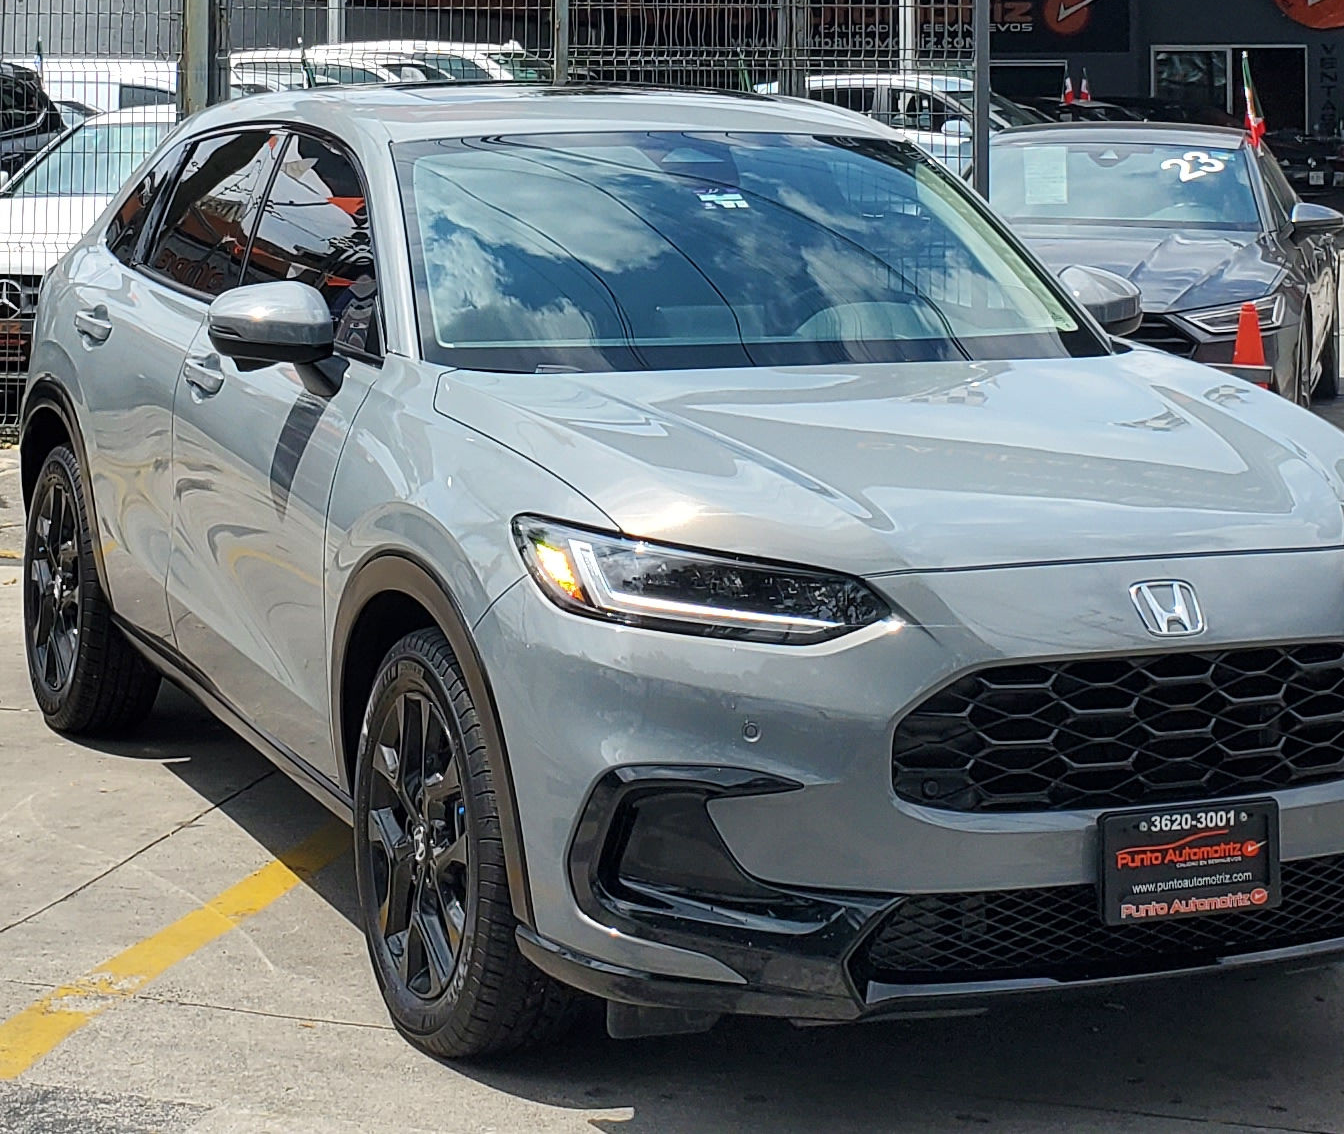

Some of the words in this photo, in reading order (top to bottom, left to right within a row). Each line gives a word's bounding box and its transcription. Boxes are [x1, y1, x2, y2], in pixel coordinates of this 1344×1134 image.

[1160, 151, 1226, 183] 23
[1150, 809, 1236, 832] 3620-3001
[1117, 851, 1162, 870] Punto
[1164, 841, 1243, 864] Automotriz
[1132, 871, 1253, 895] www.puntoautomotriz.com
[1120, 900, 1169, 919] Punto
[1169, 891, 1251, 915] Automotriz
